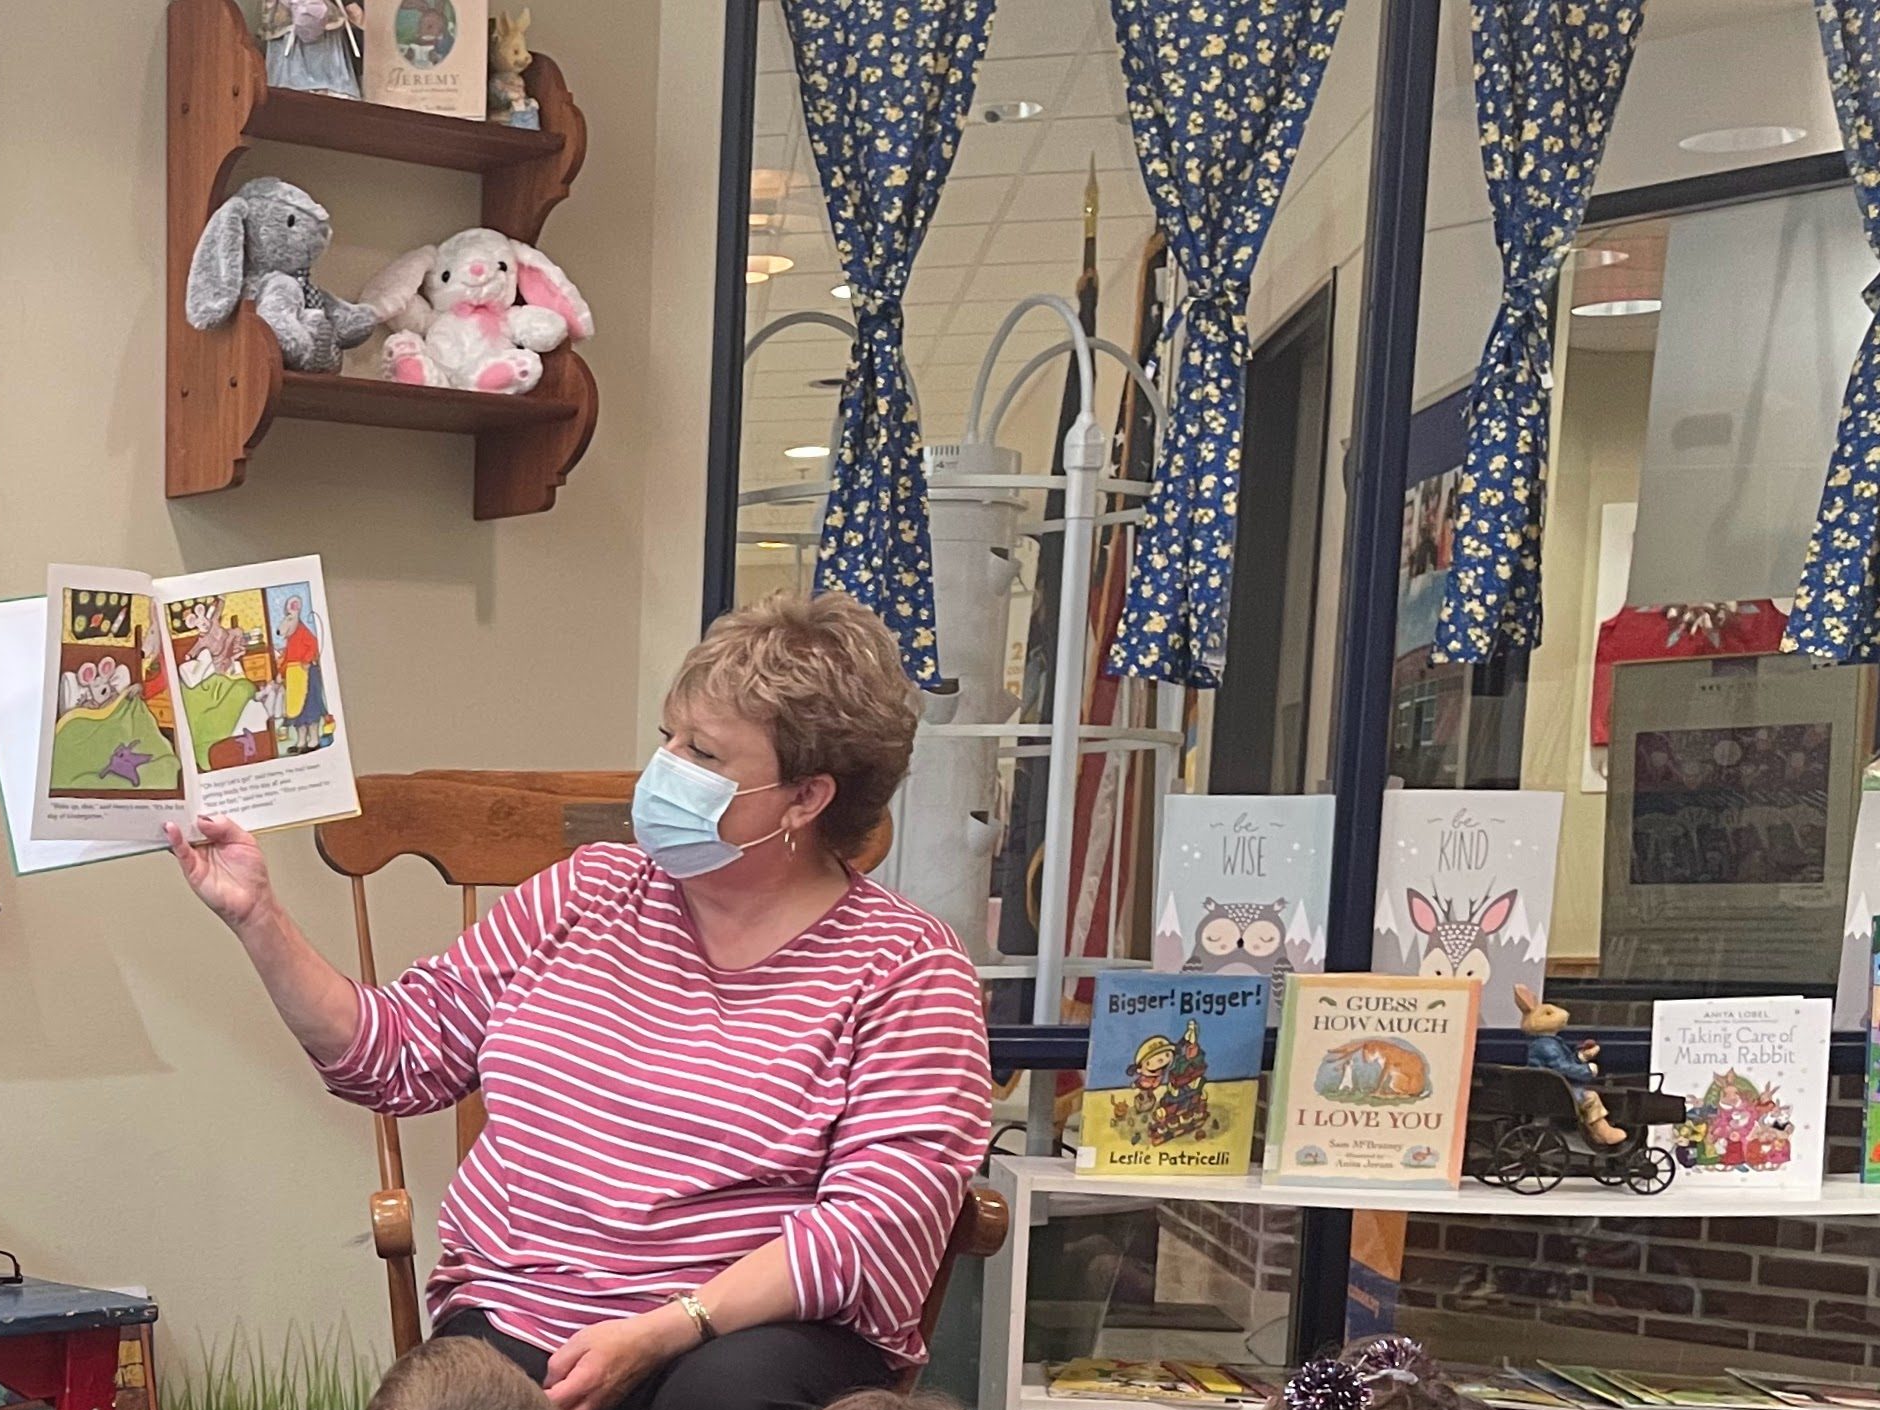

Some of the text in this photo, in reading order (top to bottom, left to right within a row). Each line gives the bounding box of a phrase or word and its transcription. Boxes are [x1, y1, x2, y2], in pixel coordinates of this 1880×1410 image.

[388, 67, 459, 88] JEREMY
[1233, 812, 1259, 833] be
[1452, 808, 1480, 828] be
[1223, 836, 1267, 877] WISE
[1438, 829, 1488, 872] KIND
[1109, 984, 1262, 1015] Bigger! Bigger!
[1346, 996, 1418, 1012] GUESS
[1739, 1010, 1768, 1018] LOBEL
[1313, 1015, 1448, 1034] HOW MUCH
[1678, 1025, 1798, 1048] Taking Care of
[1674, 1045, 1795, 1065] Mama Rabbit
[1298, 1109, 1443, 1130] I LOVE YOU
[1329, 1139, 1350, 1148] Sam
[1110, 1151, 1230, 1166] Leslie Patricelli
[1335, 1159, 1361, 1168] Anita
